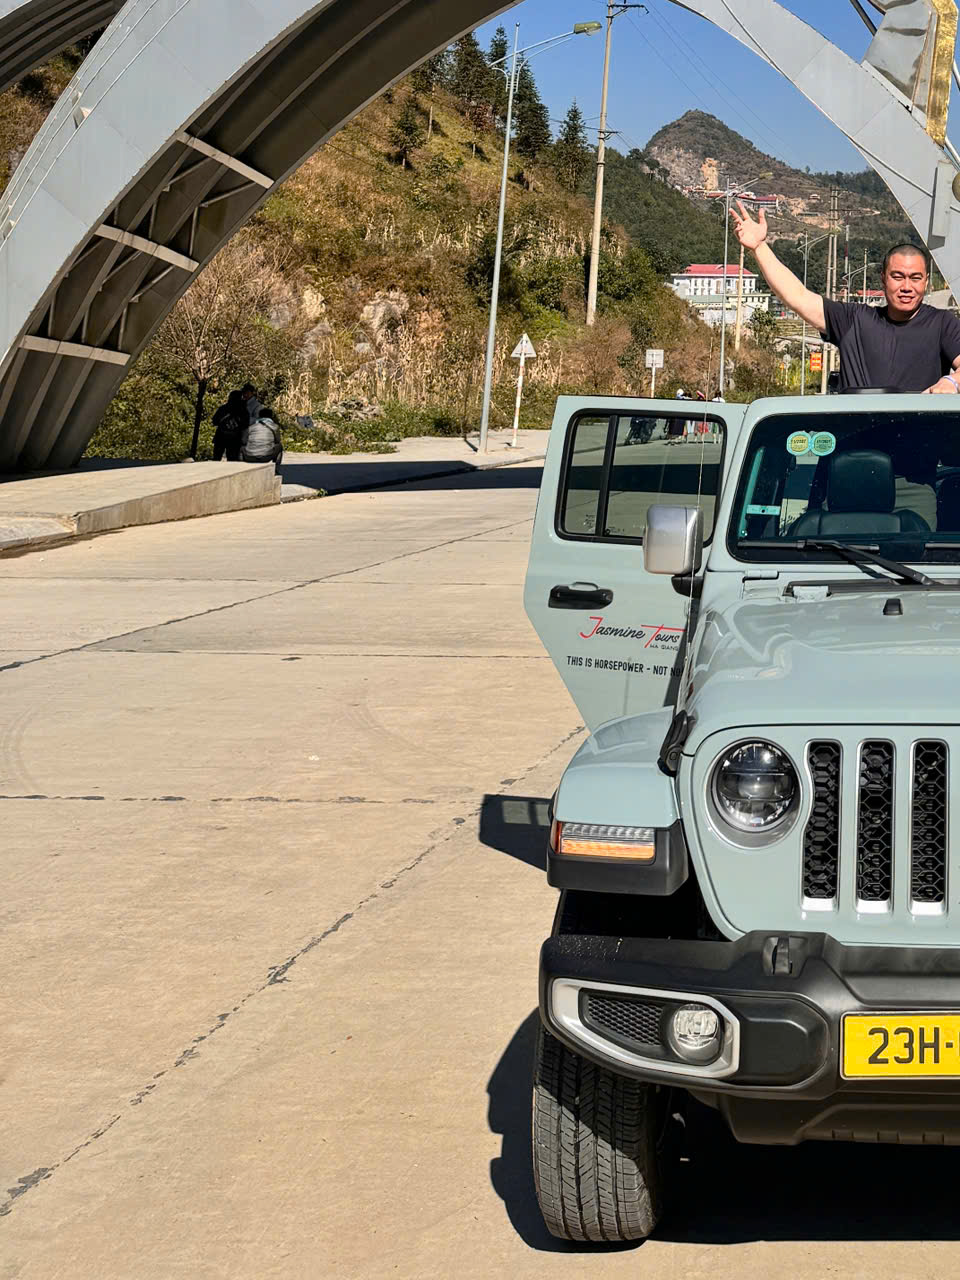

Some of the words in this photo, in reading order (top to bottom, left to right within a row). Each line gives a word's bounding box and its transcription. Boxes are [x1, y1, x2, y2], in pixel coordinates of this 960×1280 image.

[578, 615, 646, 639] Jasmine
[640, 624, 687, 649] Tours
[567, 655, 584, 668] THIS
[585, 658, 593, 668] IS
[594, 659, 644, 673] HORSEPOWER
[653, 665, 668, 676] NOT
